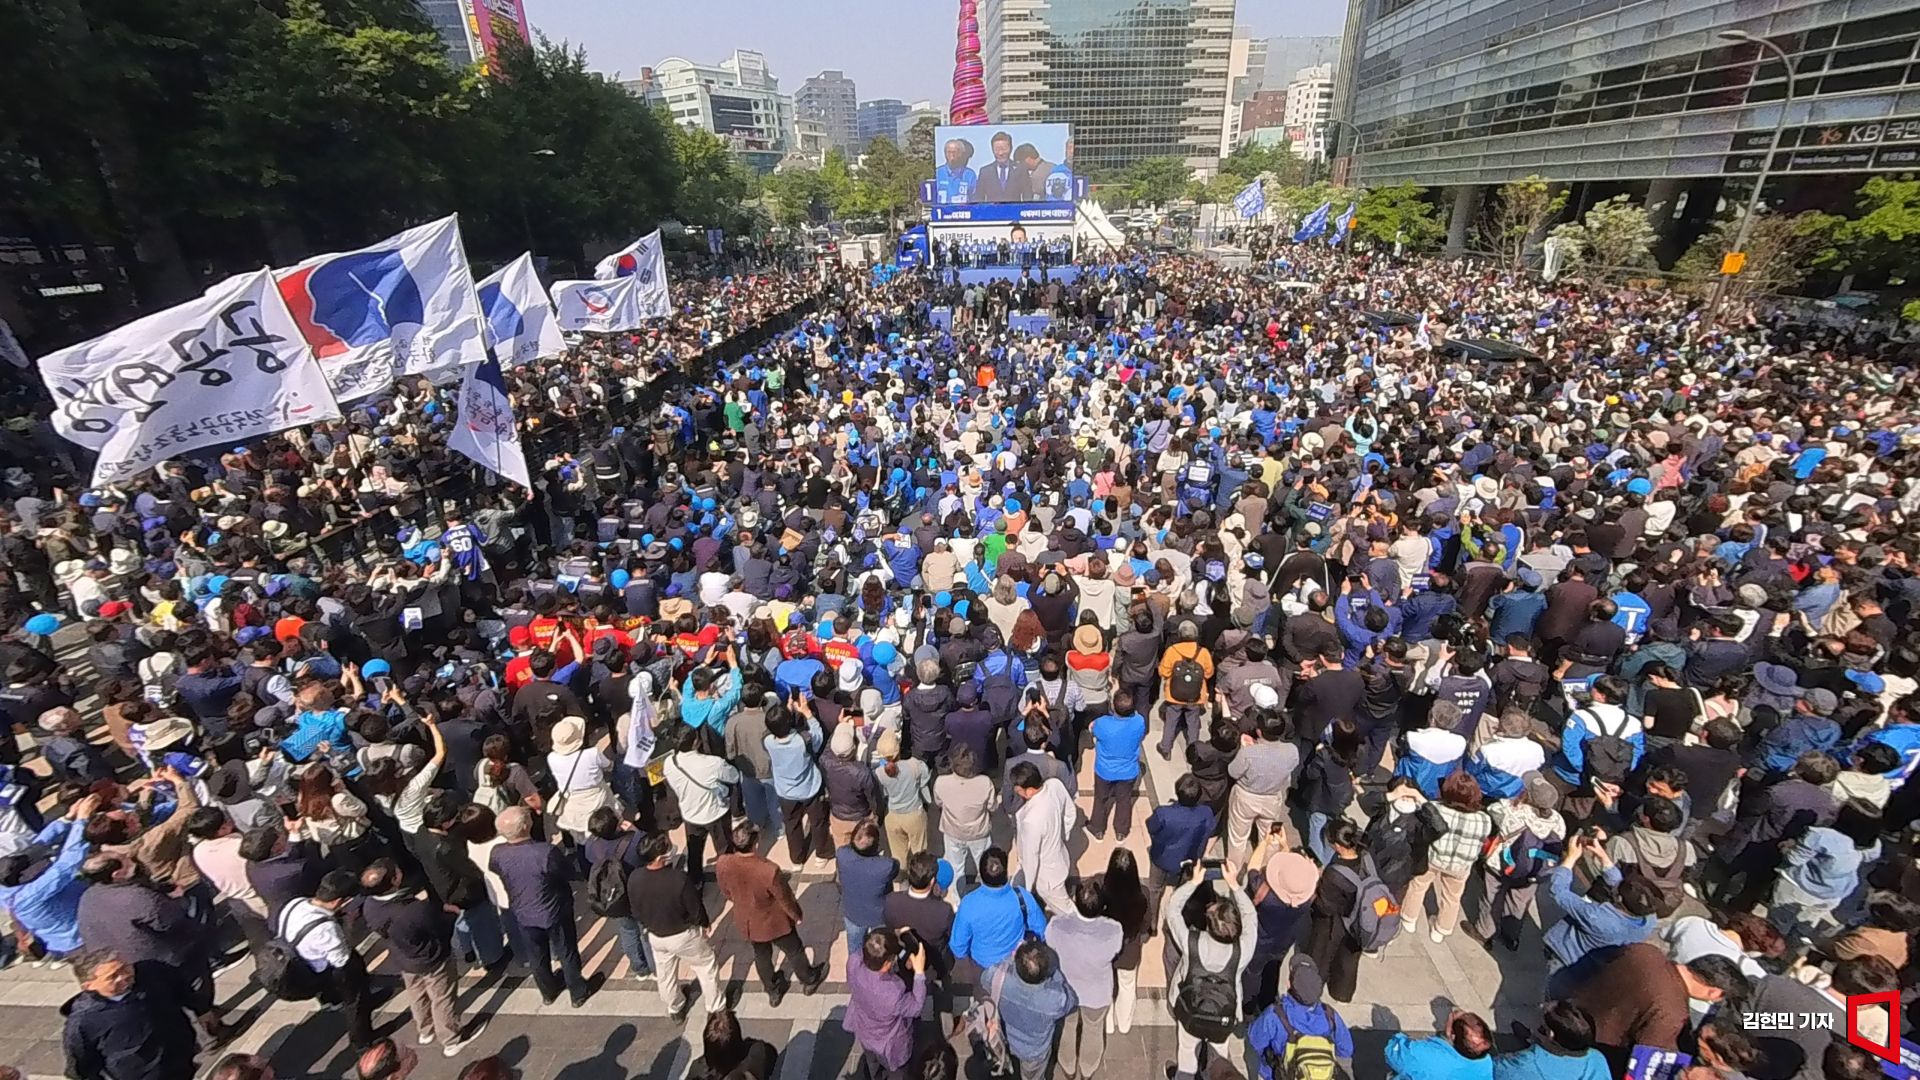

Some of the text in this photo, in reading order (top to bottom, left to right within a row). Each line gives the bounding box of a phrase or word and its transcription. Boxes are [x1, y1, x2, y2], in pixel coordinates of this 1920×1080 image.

[925, 183, 932, 201] 1
[1077, 179, 1084, 197] 1
[936, 208, 942, 219] 1
[939, 232, 973, 243] 이제부터
[450, 537, 473, 552] 60
